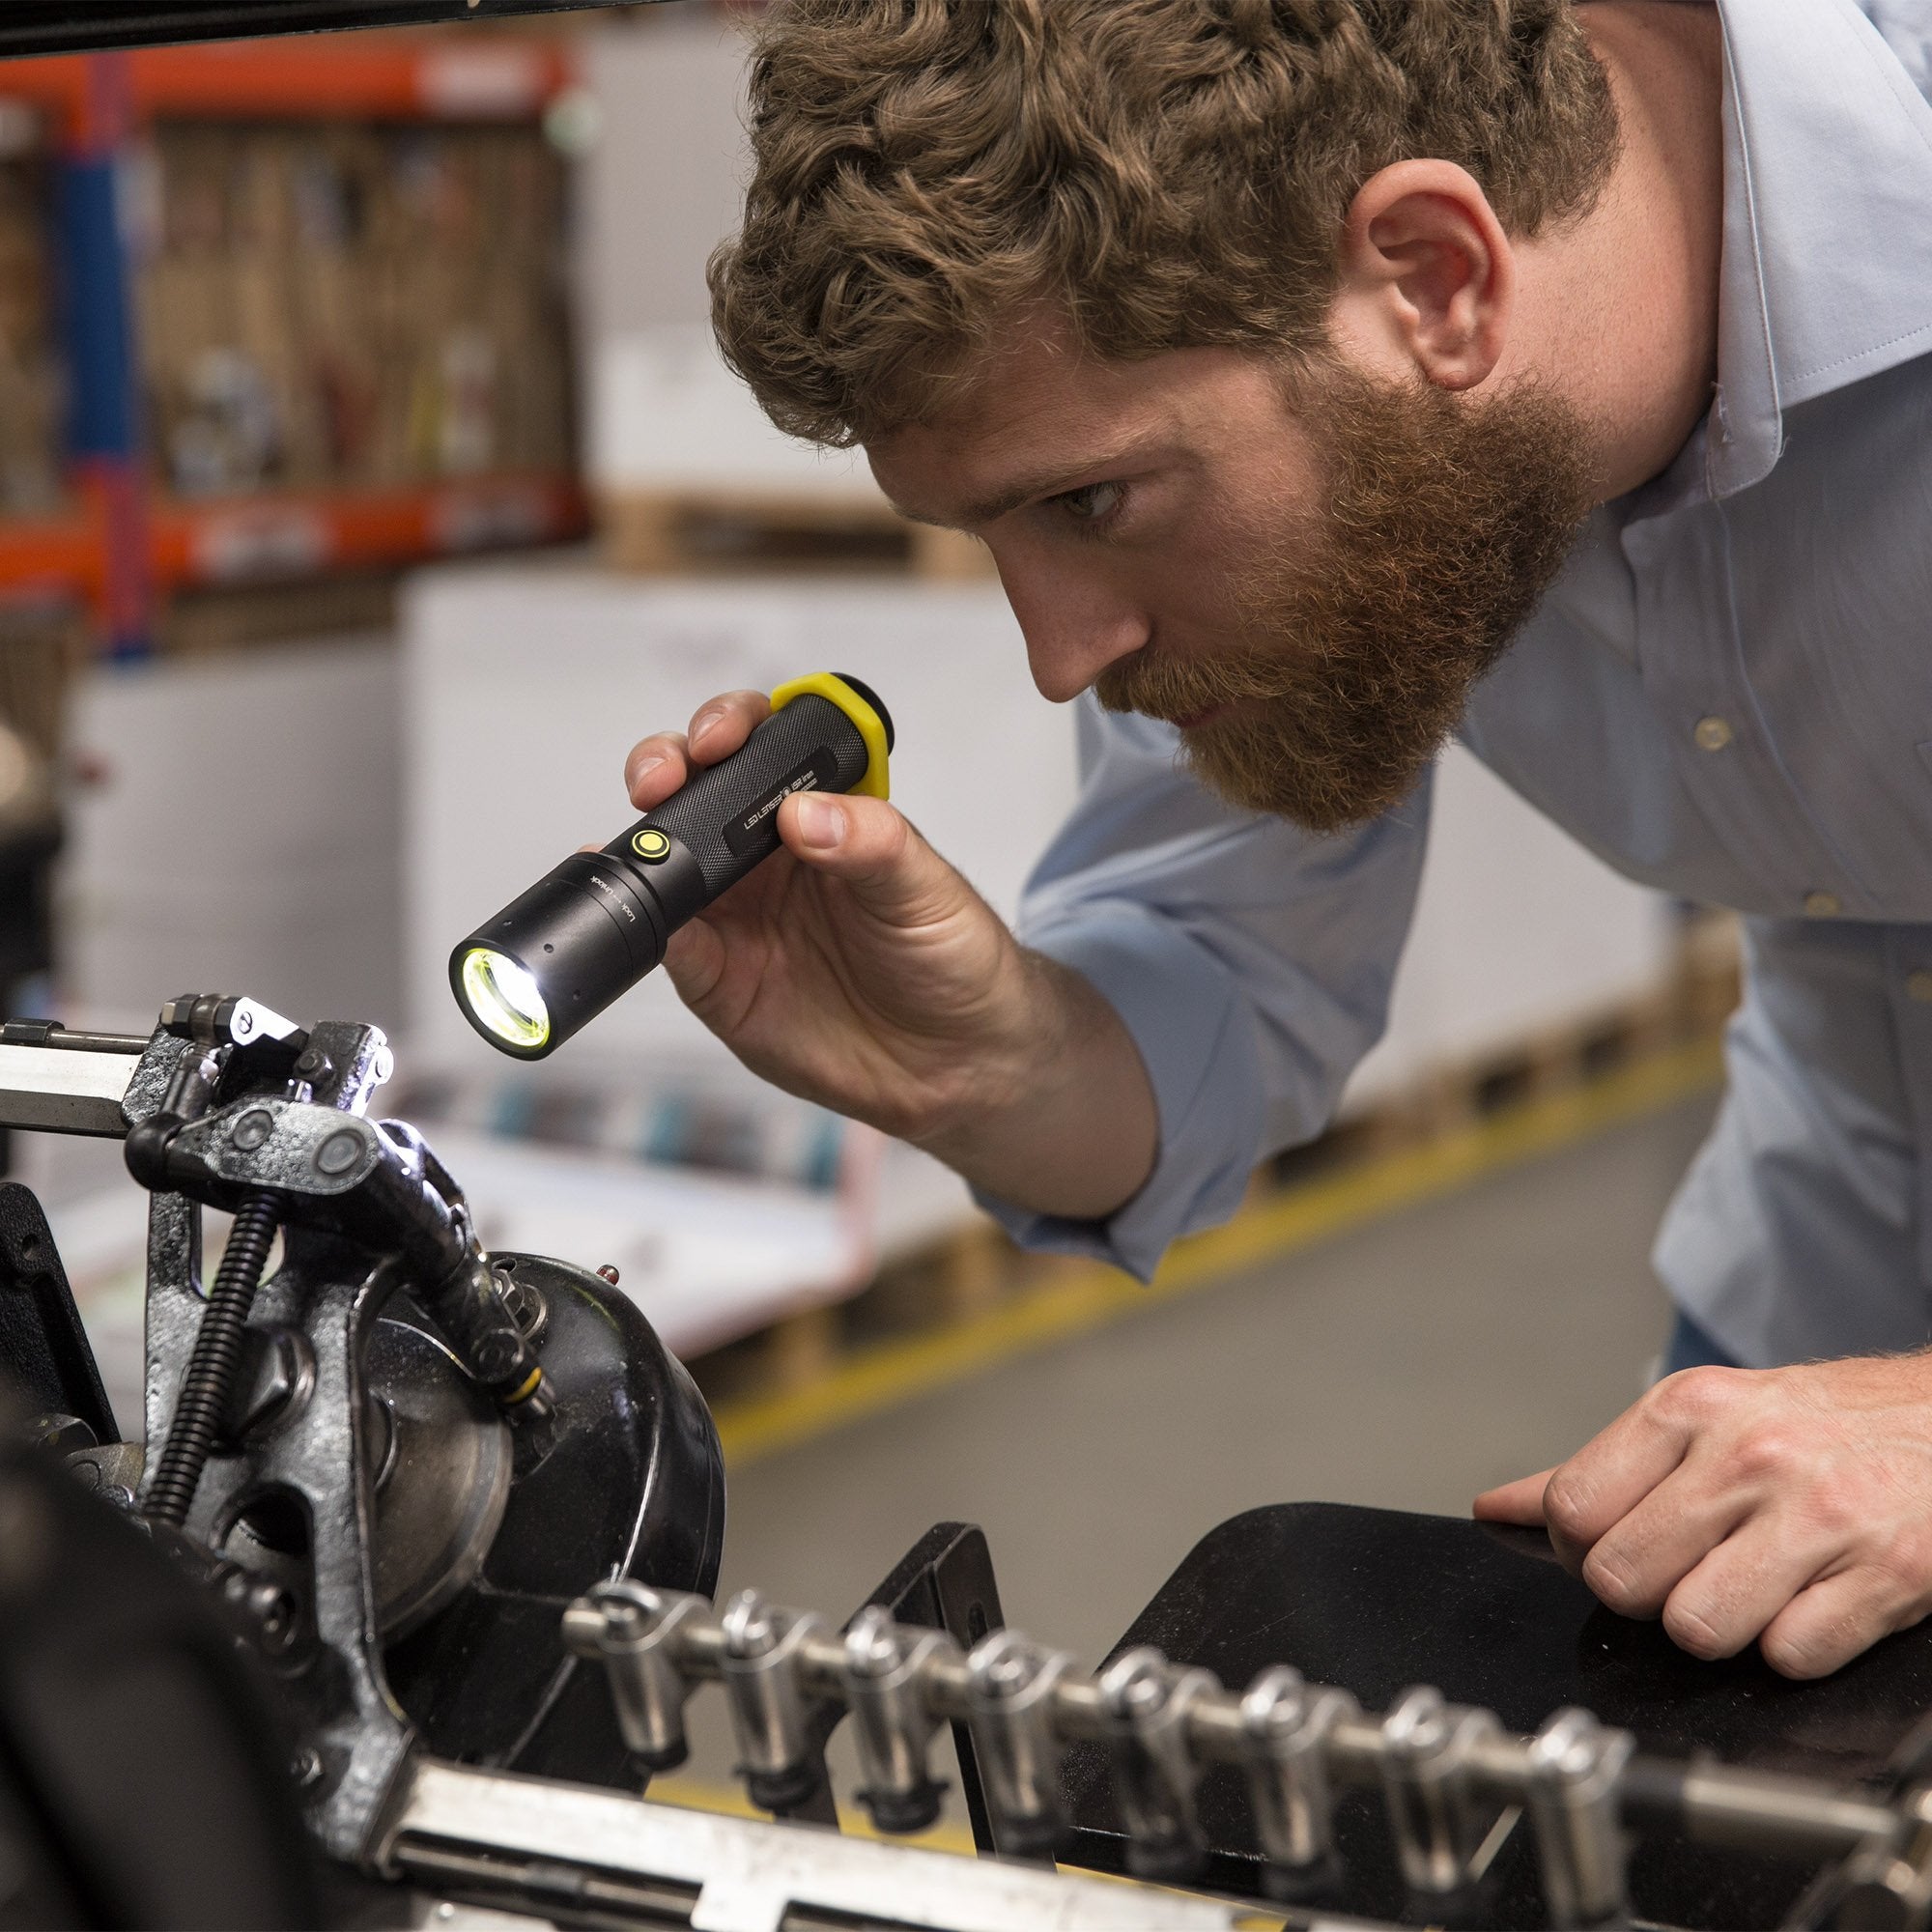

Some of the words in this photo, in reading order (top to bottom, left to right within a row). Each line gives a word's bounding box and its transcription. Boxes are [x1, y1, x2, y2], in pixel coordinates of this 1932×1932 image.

[744, 814, 758, 830] LED
[801, 770, 814, 782] iron
[590, 875, 613, 895] Unlock
[621, 903, 636, 923] Lock
